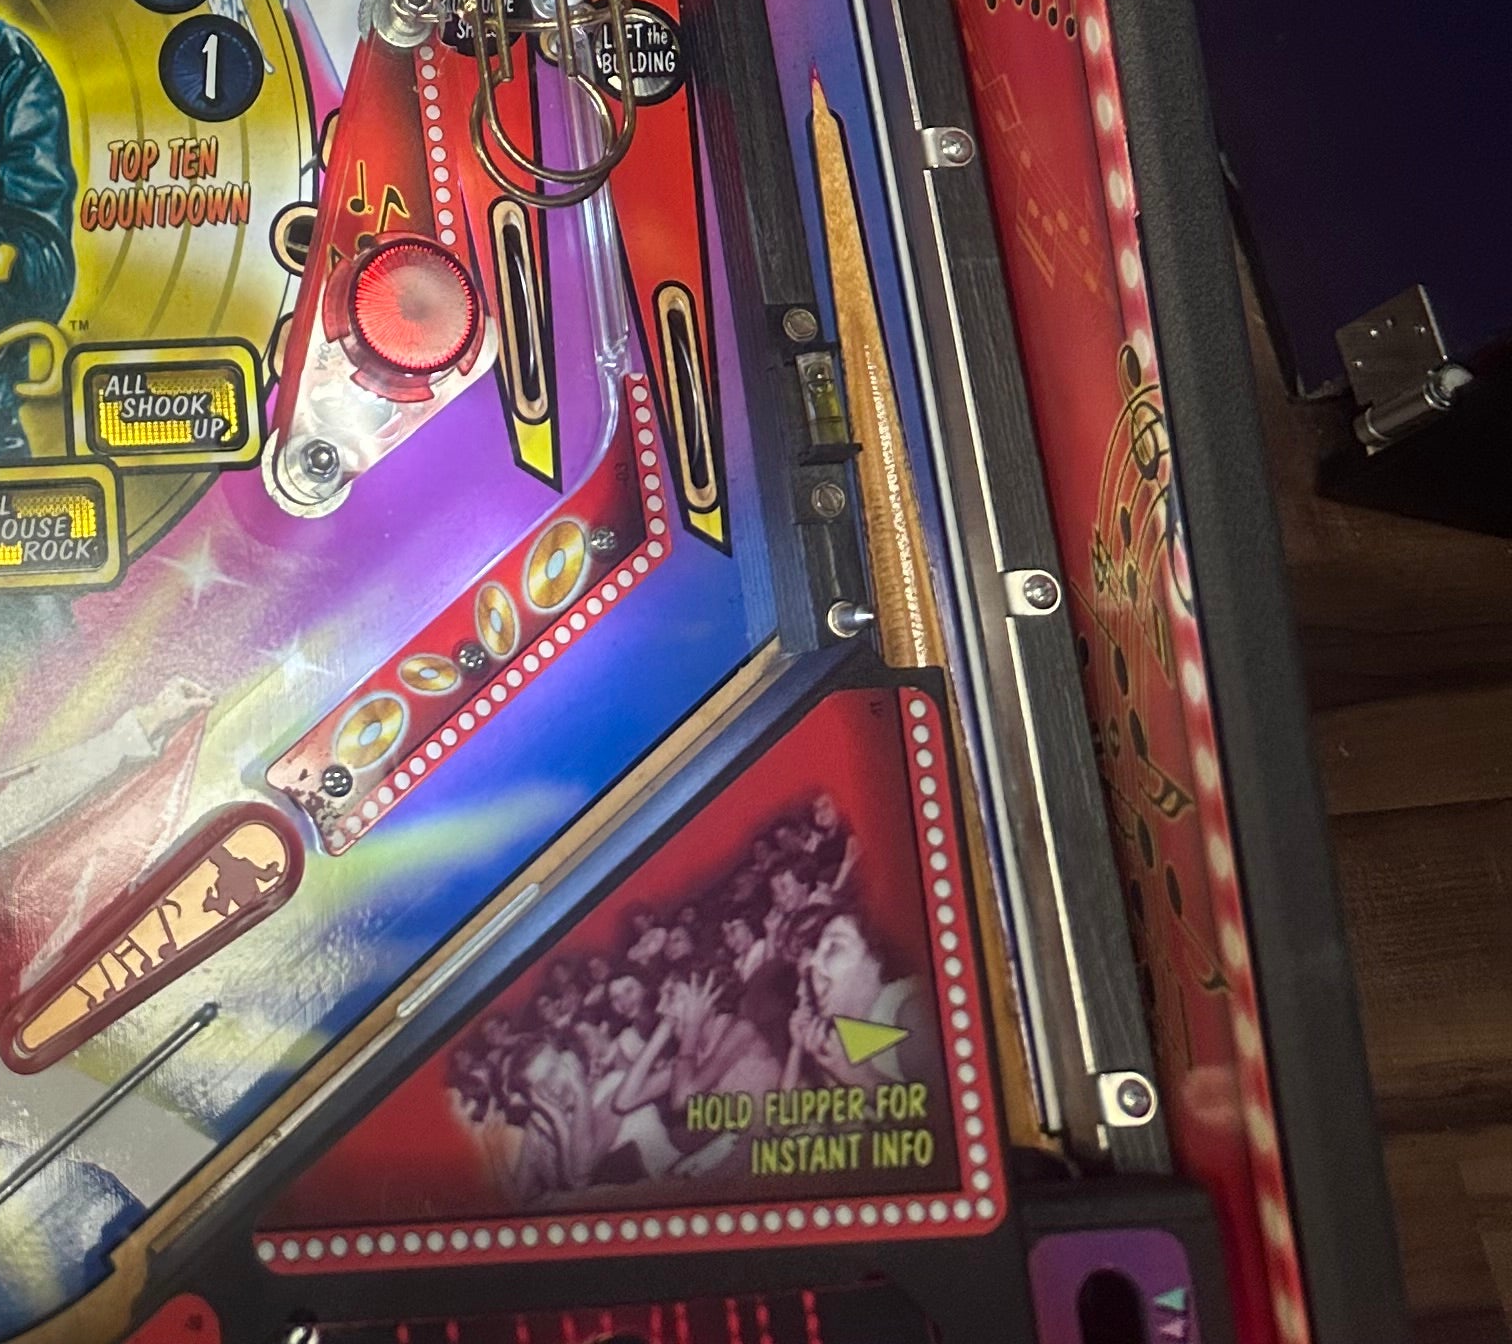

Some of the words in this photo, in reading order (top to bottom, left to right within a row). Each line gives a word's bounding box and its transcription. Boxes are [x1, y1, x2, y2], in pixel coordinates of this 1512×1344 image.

[646, 20, 669, 46] the
[201, 33, 220, 101] 1
[108, 138, 161, 182] TOP
[166, 135, 220, 180] TEN
[80, 181, 252, 234] COUNTDOWN
[104, 373, 148, 398] ALL
[119, 395, 207, 419] SHOOK
[192, 416, 226, 440] UP
[21, 539, 92, 562] ROCK
[688, 1092, 754, 1132] HOLD
[764, 1086, 869, 1128] FLIPPER
[874, 1083, 928, 1120] FOR
[750, 1131, 861, 1175] INSTANT
[872, 1126, 935, 1169] INFO
